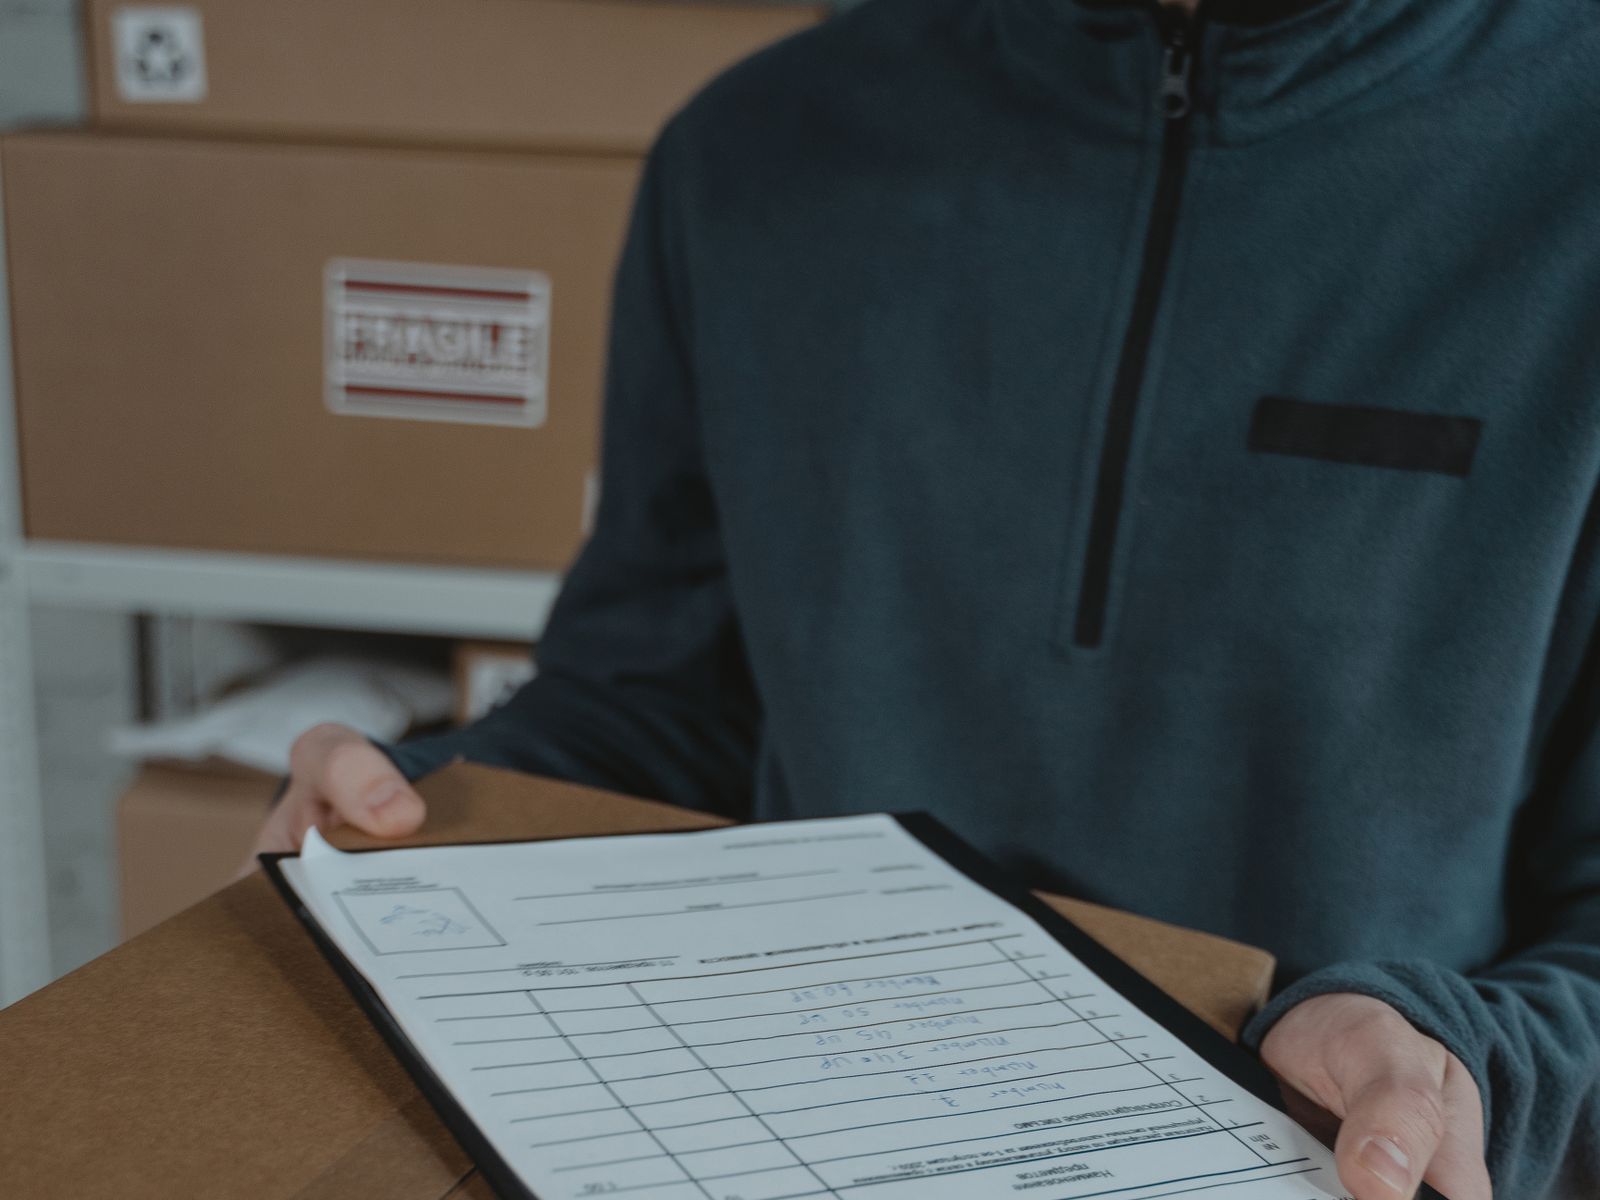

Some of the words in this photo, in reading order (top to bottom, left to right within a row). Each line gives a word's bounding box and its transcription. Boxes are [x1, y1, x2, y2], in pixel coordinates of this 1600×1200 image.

[344, 312, 530, 371] FRAGILE
[1056, 1097, 1187, 1123] Сопроводительное
[1009, 1115, 1065, 1130] письмо
[1007, 1168, 1115, 1192] Наименование
[1011, 1161, 1093, 1181] предметов
